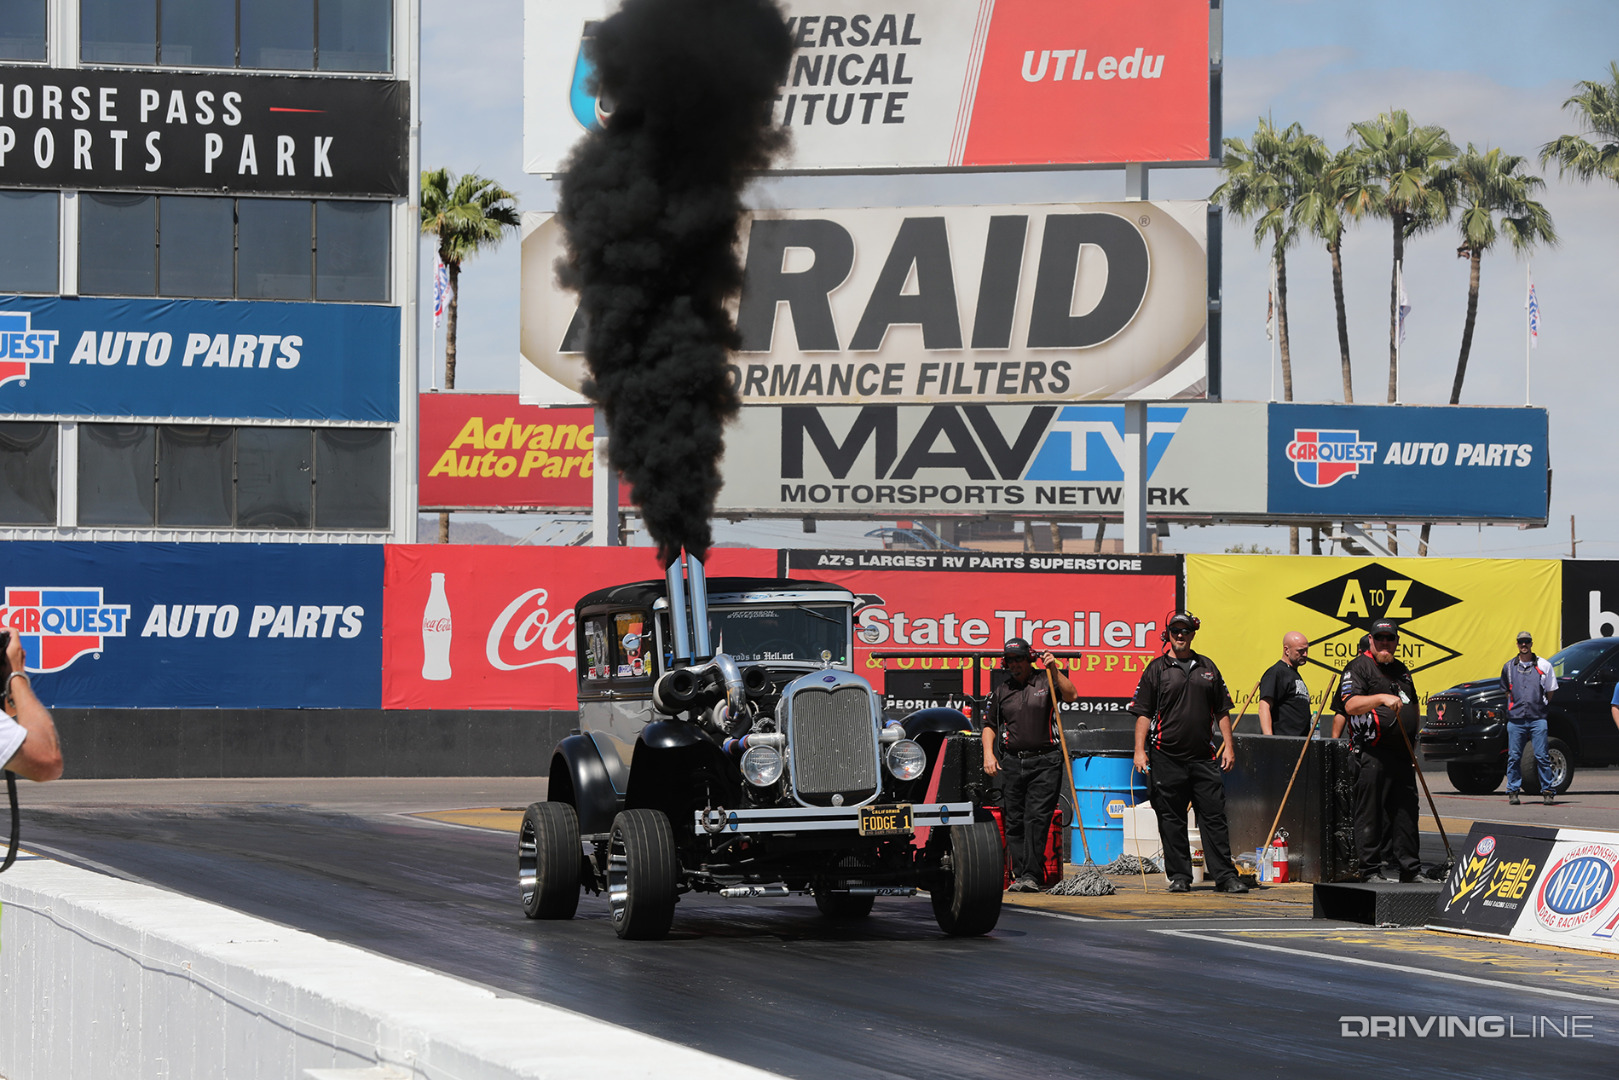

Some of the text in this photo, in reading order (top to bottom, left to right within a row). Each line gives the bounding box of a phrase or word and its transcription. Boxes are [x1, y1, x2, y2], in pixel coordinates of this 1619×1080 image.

[779, 53, 913, 86] NICAL
[1021, 48, 1164, 82] UTI.edu
[0, 83, 242, 126] ORSE PASS
[205, 133, 333, 177] PARK
[69, 331, 303, 369] AUTO PARTS
[916, 360, 1072, 396] FILTERS
[449, 416, 594, 450] Advanc
[428, 450, 594, 478] Auto Part
[1288, 443, 1375, 462] CARQUEST
[1383, 442, 1533, 467] AUTO PARTS
[781, 484, 1190, 506] MOTORSPORTS NETWRK
[818, 554, 1142, 571] AZ's LARGEST RV PARTS SUPERSTORE
[1336, 579, 1369, 618] A
[1383, 579, 1413, 618] Z
[0, 608, 127, 634] CARQUEST
[141, 604, 364, 639] AUTO PARTS
[857, 608, 1155, 649] State Trailer
[863, 815, 911, 831] FODGE 1
[1564, 845, 1618, 864] CHAMPIONSHIP
[1548, 860, 1609, 910] NHRA
[1539, 906, 1556, 926] DRAG
[1556, 912, 1589, 928] RACING
